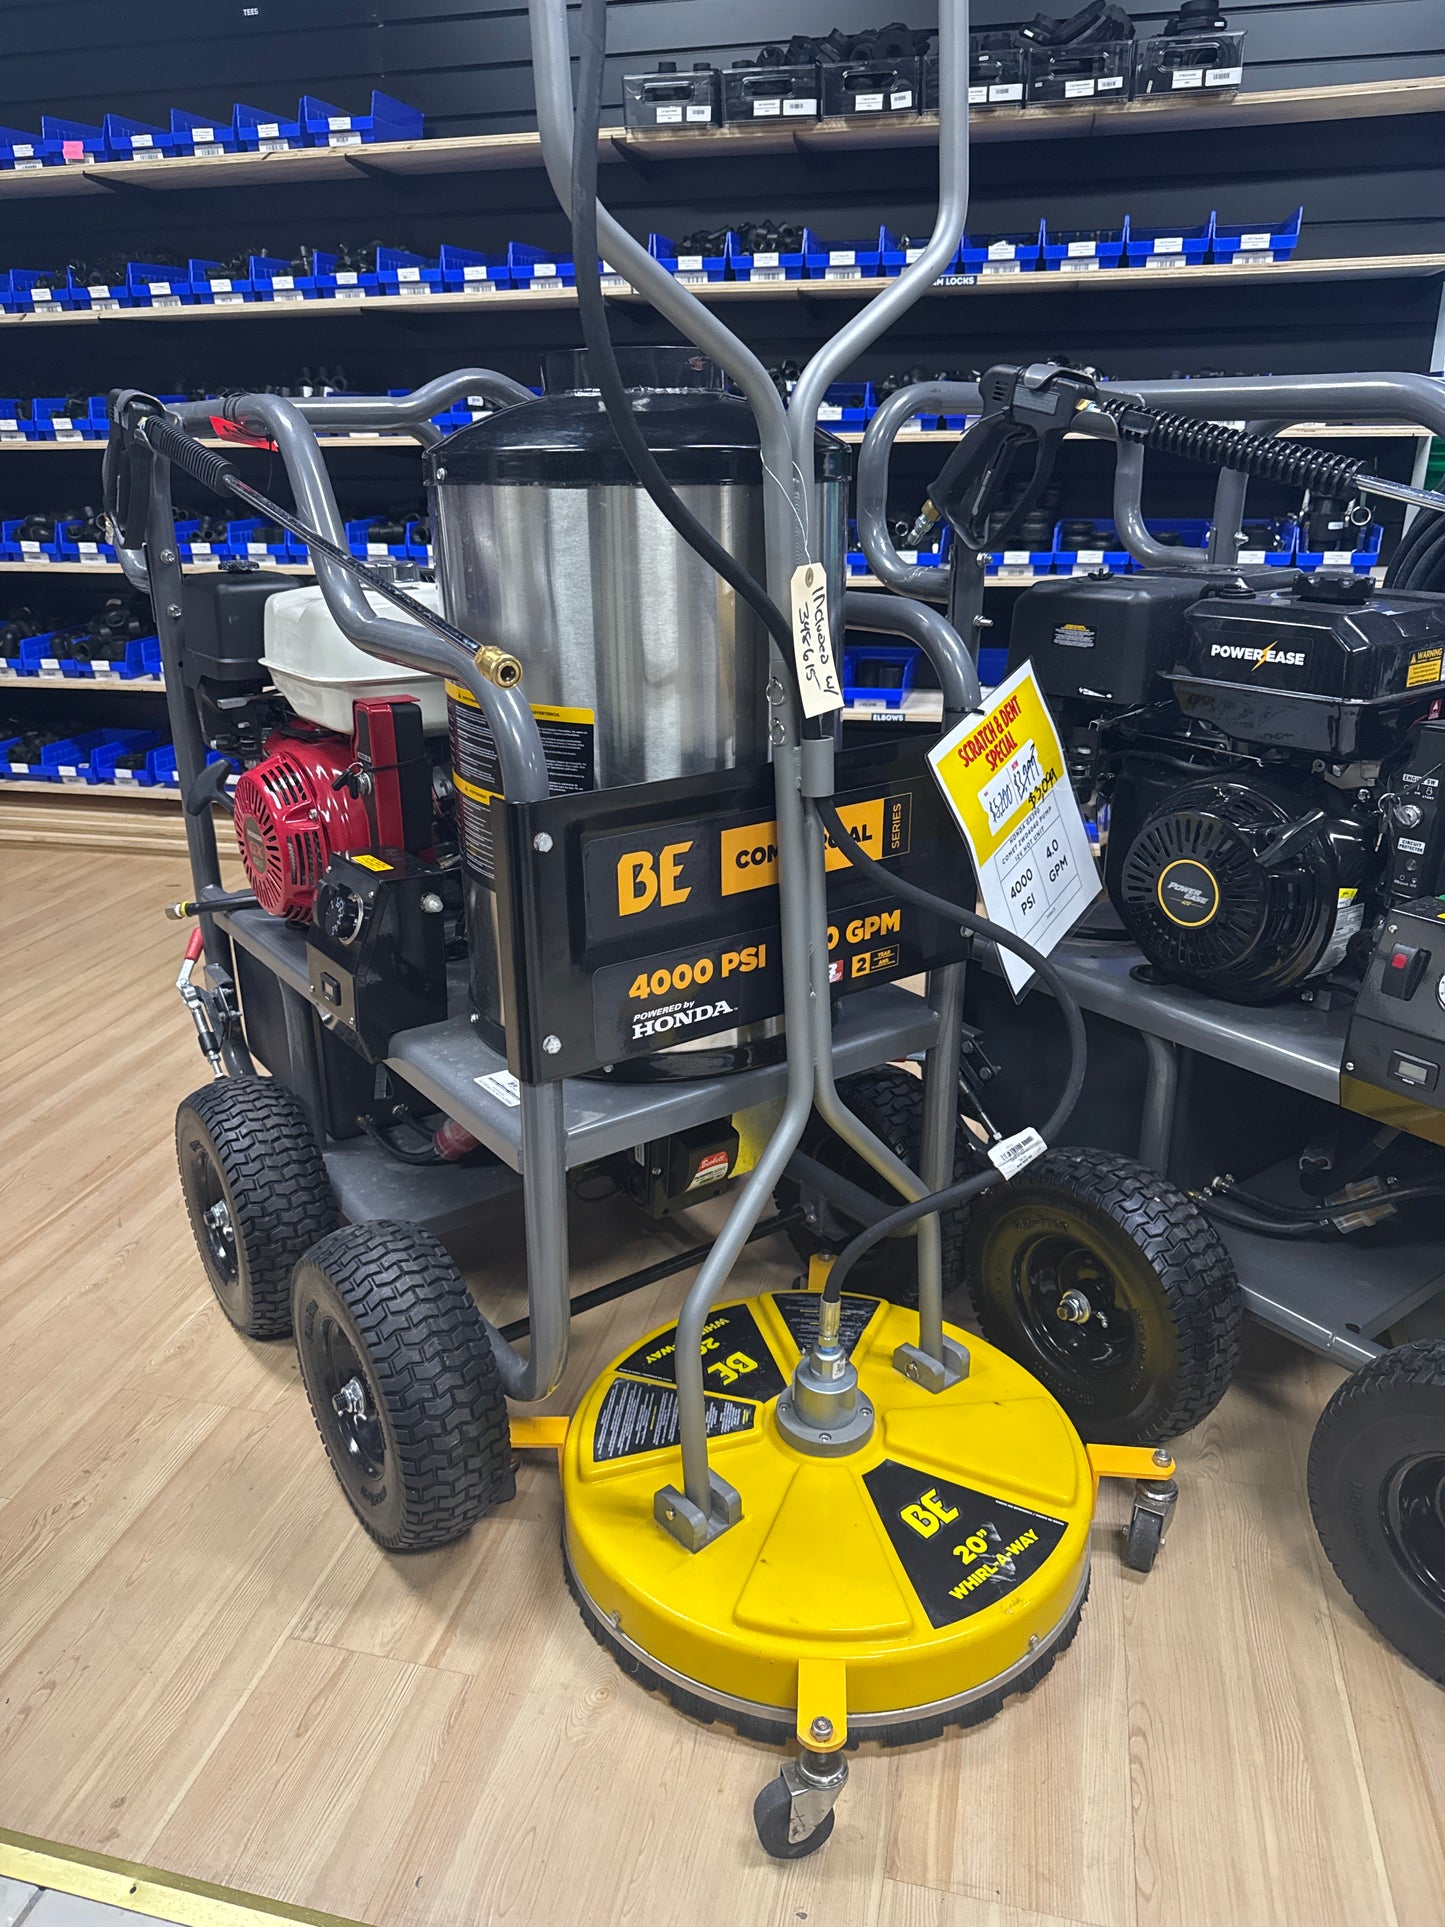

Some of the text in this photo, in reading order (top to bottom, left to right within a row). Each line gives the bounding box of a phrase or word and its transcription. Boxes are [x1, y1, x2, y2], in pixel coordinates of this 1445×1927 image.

[243, 8, 259, 16] TEES
[946, 277, 975, 285] LOCKS
[1417, 648, 1443, 660] WARNING
[957, 695, 1022, 768] SCRATCH & DENT
[985, 731, 1018, 772] SPECIAL
[891, 803, 902, 849] SERIES
[1001, 845, 1018, 865] COMET
[1040, 806, 1052, 821] PUMP
[1009, 823, 1026, 845] HONDA
[1014, 826, 1045, 863] 12V HOT UNIT
[1046, 839, 1059, 859] 4.0
[1399, 844, 1423, 853] PROTECTOR
[1402, 840, 1423, 848] CIRCUIT
[617, 840, 694, 917] BE
[1049, 855, 1068, 882] GPM
[1010, 868, 1033, 899] 4000
[1167, 881, 1202, 897] POWER
[1020, 893, 1036, 916] PSI
[1183, 893, 1209, 904] EASE
[845, 909, 901, 944] GPM
[628, 943, 766, 1000] 4000 PSI
[856, 957, 867, 973] 2
[632, 1000, 733, 1040] HONDA
[633, 1001, 696, 1022] POWERED by
[706, 1351, 759, 1386] BE
[900, 1487, 960, 1540] BE
[948, 1528, 1040, 1600] WHIRL-A-WAY
